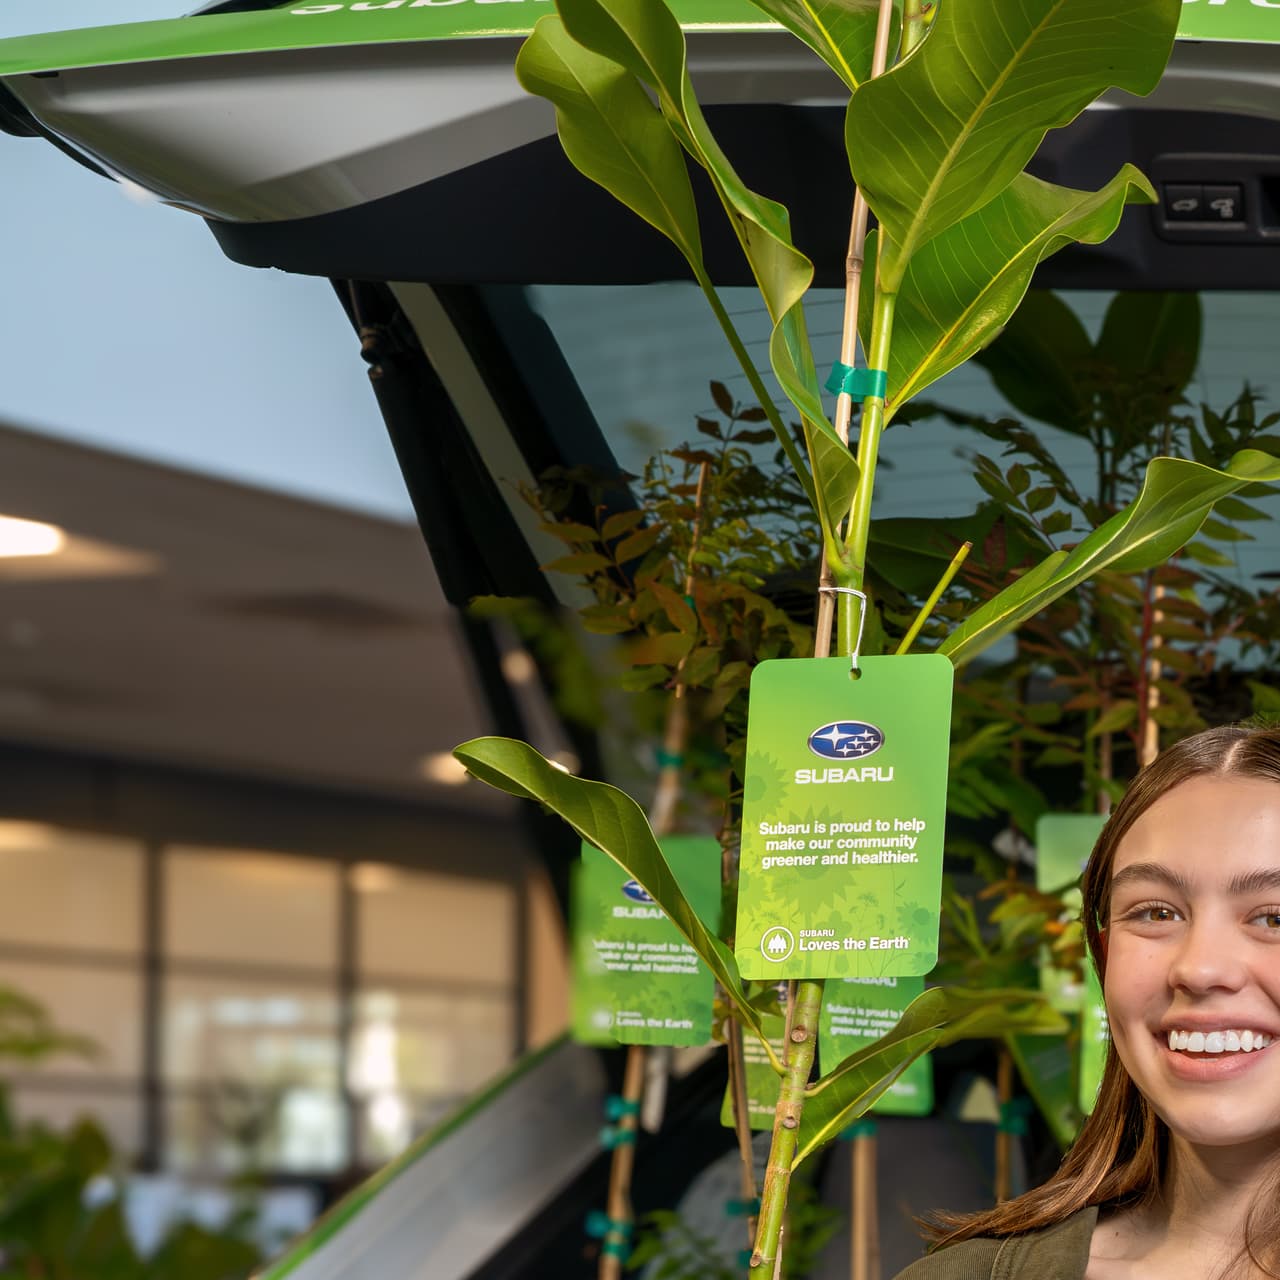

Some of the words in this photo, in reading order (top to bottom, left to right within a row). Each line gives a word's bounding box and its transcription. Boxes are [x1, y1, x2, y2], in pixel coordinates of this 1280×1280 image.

[795, 766, 894, 785] SUBARU
[759, 821, 810, 836] Subaru
[813, 821, 826, 834] is
[830, 820, 871, 837] proud
[875, 819, 891, 833] to
[894, 818, 926, 835] help
[765, 837, 806, 851] make
[809, 838, 833, 850] our
[836, 835, 917, 852] community
[761, 854, 817, 869] greener
[821, 852, 848, 866] and
[852, 851, 919, 865] healthier.
[613, 907, 669, 919] SUBA
[799, 929, 835, 937] SUBARU
[593, 940, 625, 951] ubaru
[799, 938, 840, 952] Loves
[843, 937, 866, 950] the
